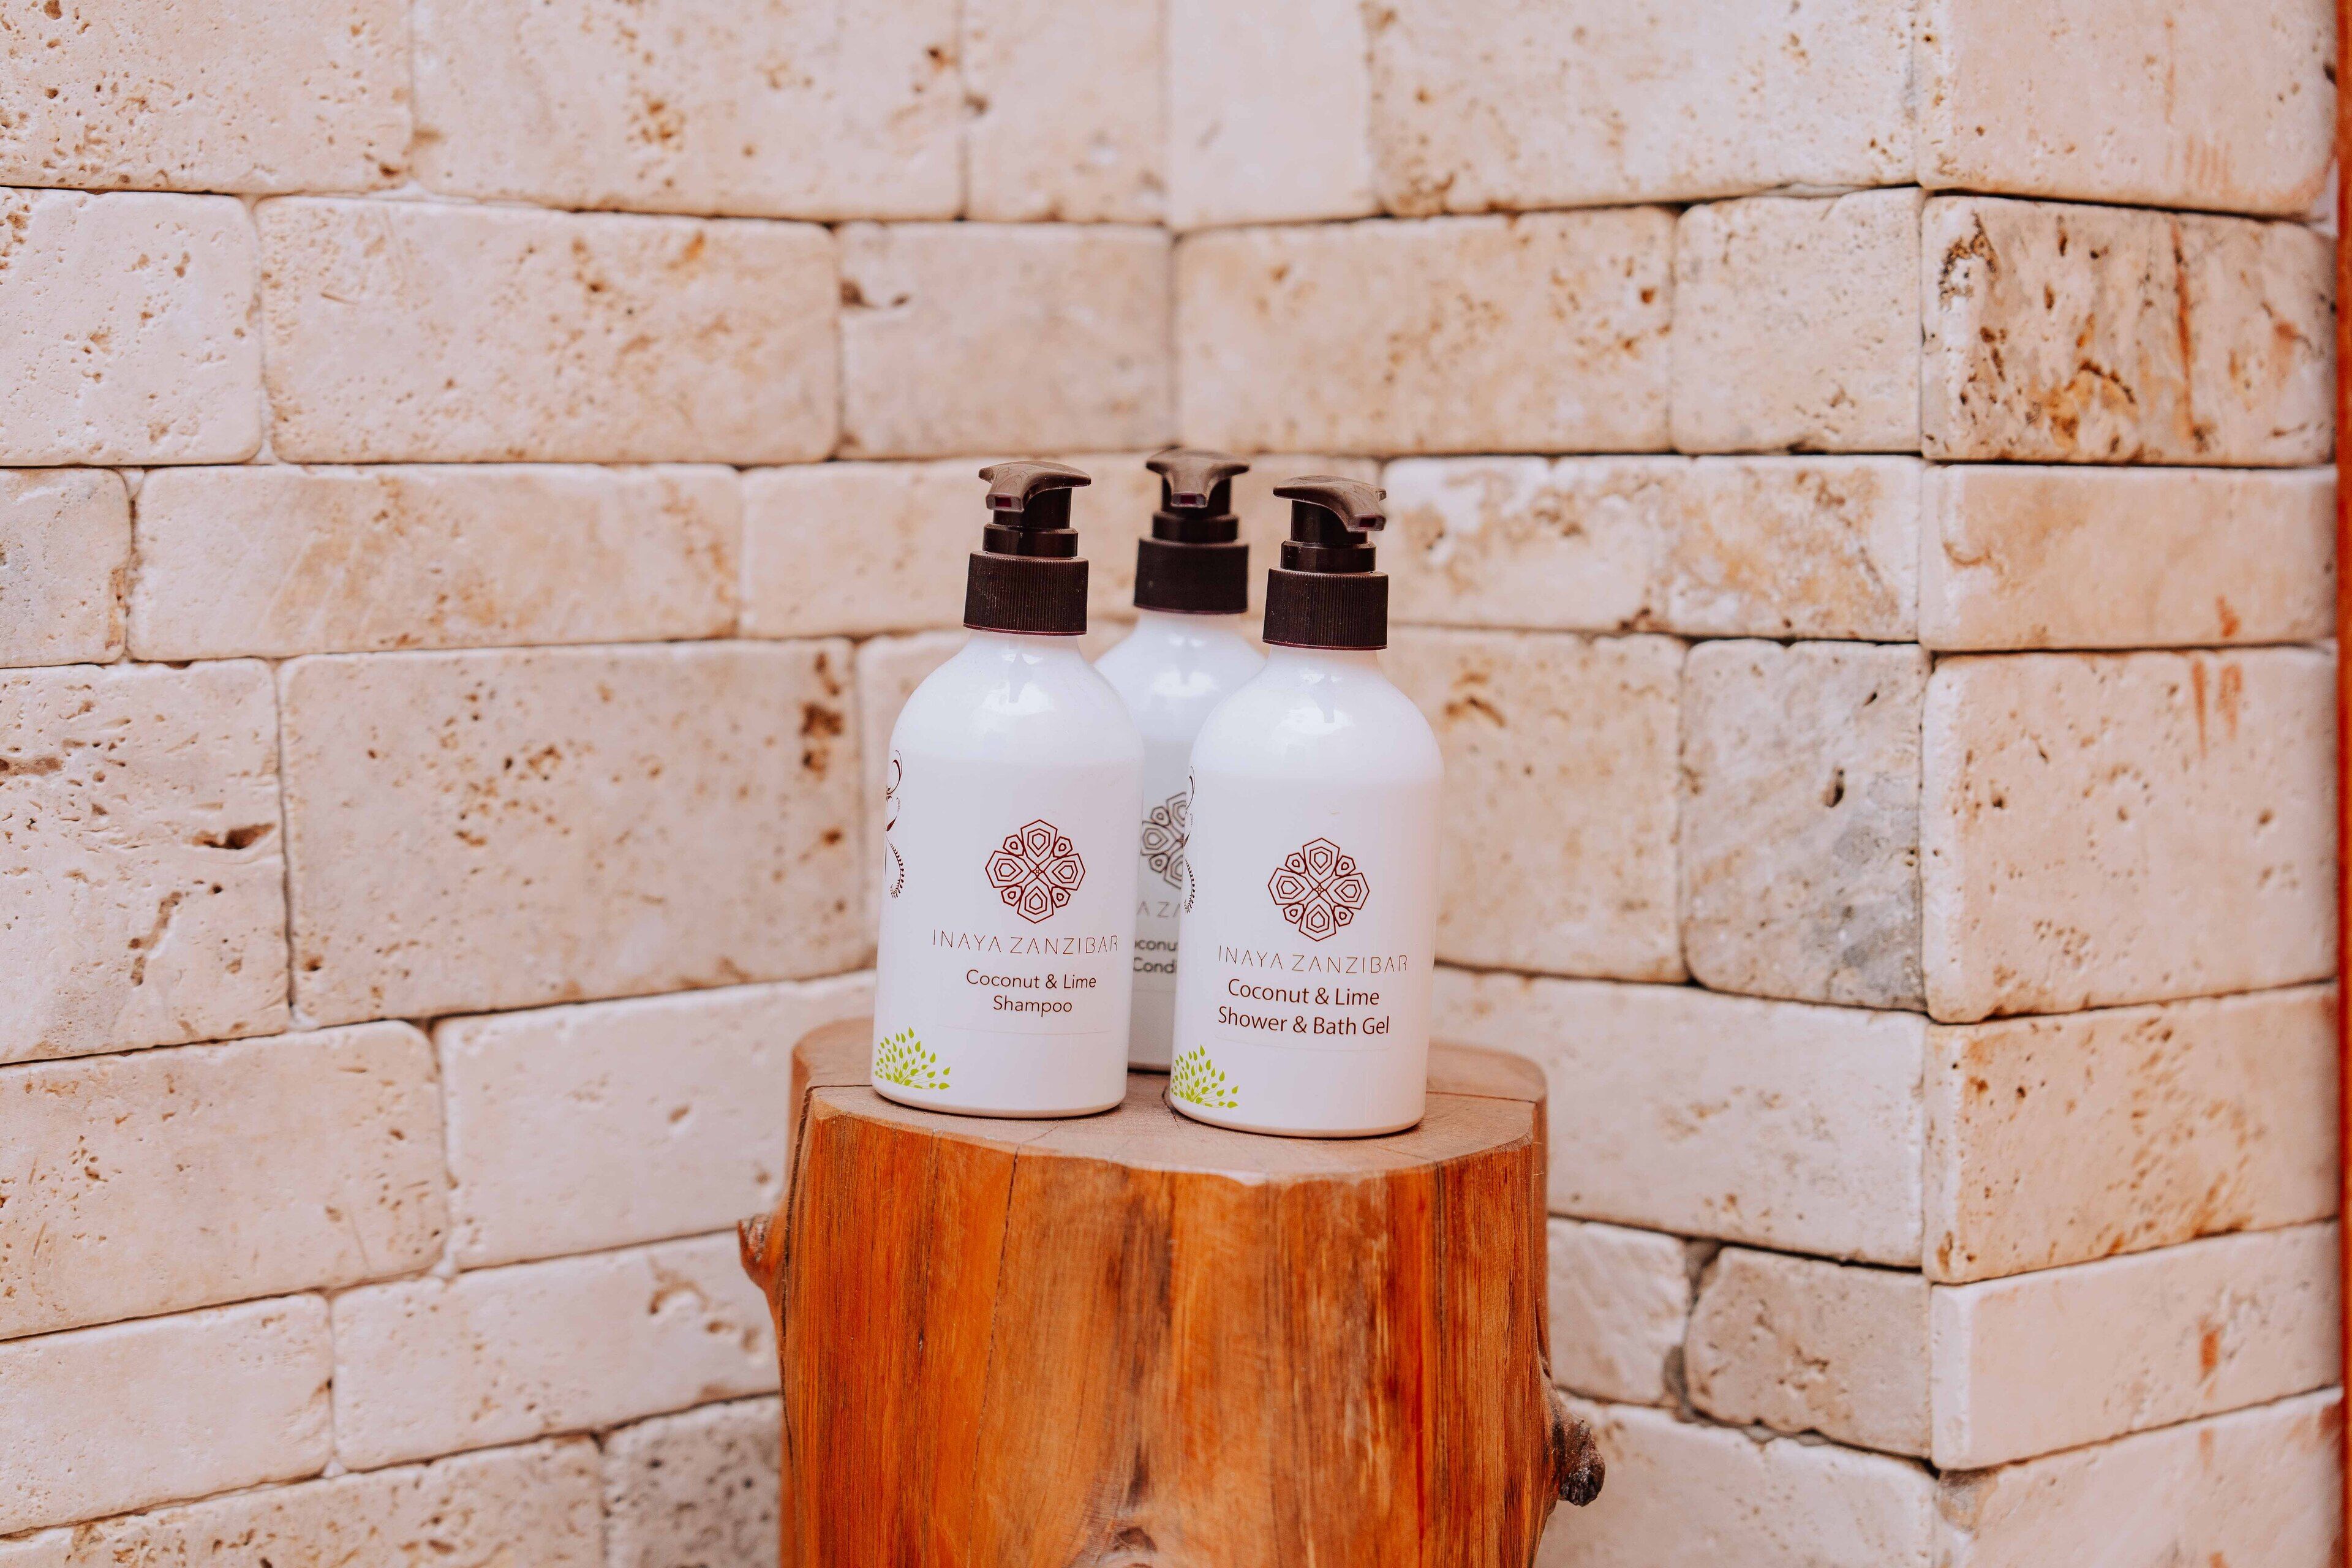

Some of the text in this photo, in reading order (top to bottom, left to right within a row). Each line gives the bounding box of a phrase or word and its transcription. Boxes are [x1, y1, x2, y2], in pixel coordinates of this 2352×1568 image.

[932, 929, 1118, 955] INAYA ZANZIBAR
[1218, 945, 1408, 974] INAYA ZANZIBAR
[966, 969, 1096, 989] Coconut & Lime
[1228, 978, 1379, 1006] Coconut & Lime
[993, 995, 1072, 1017] Shampoo
[1218, 1006, 1390, 1035] Shower & Bath Gel
